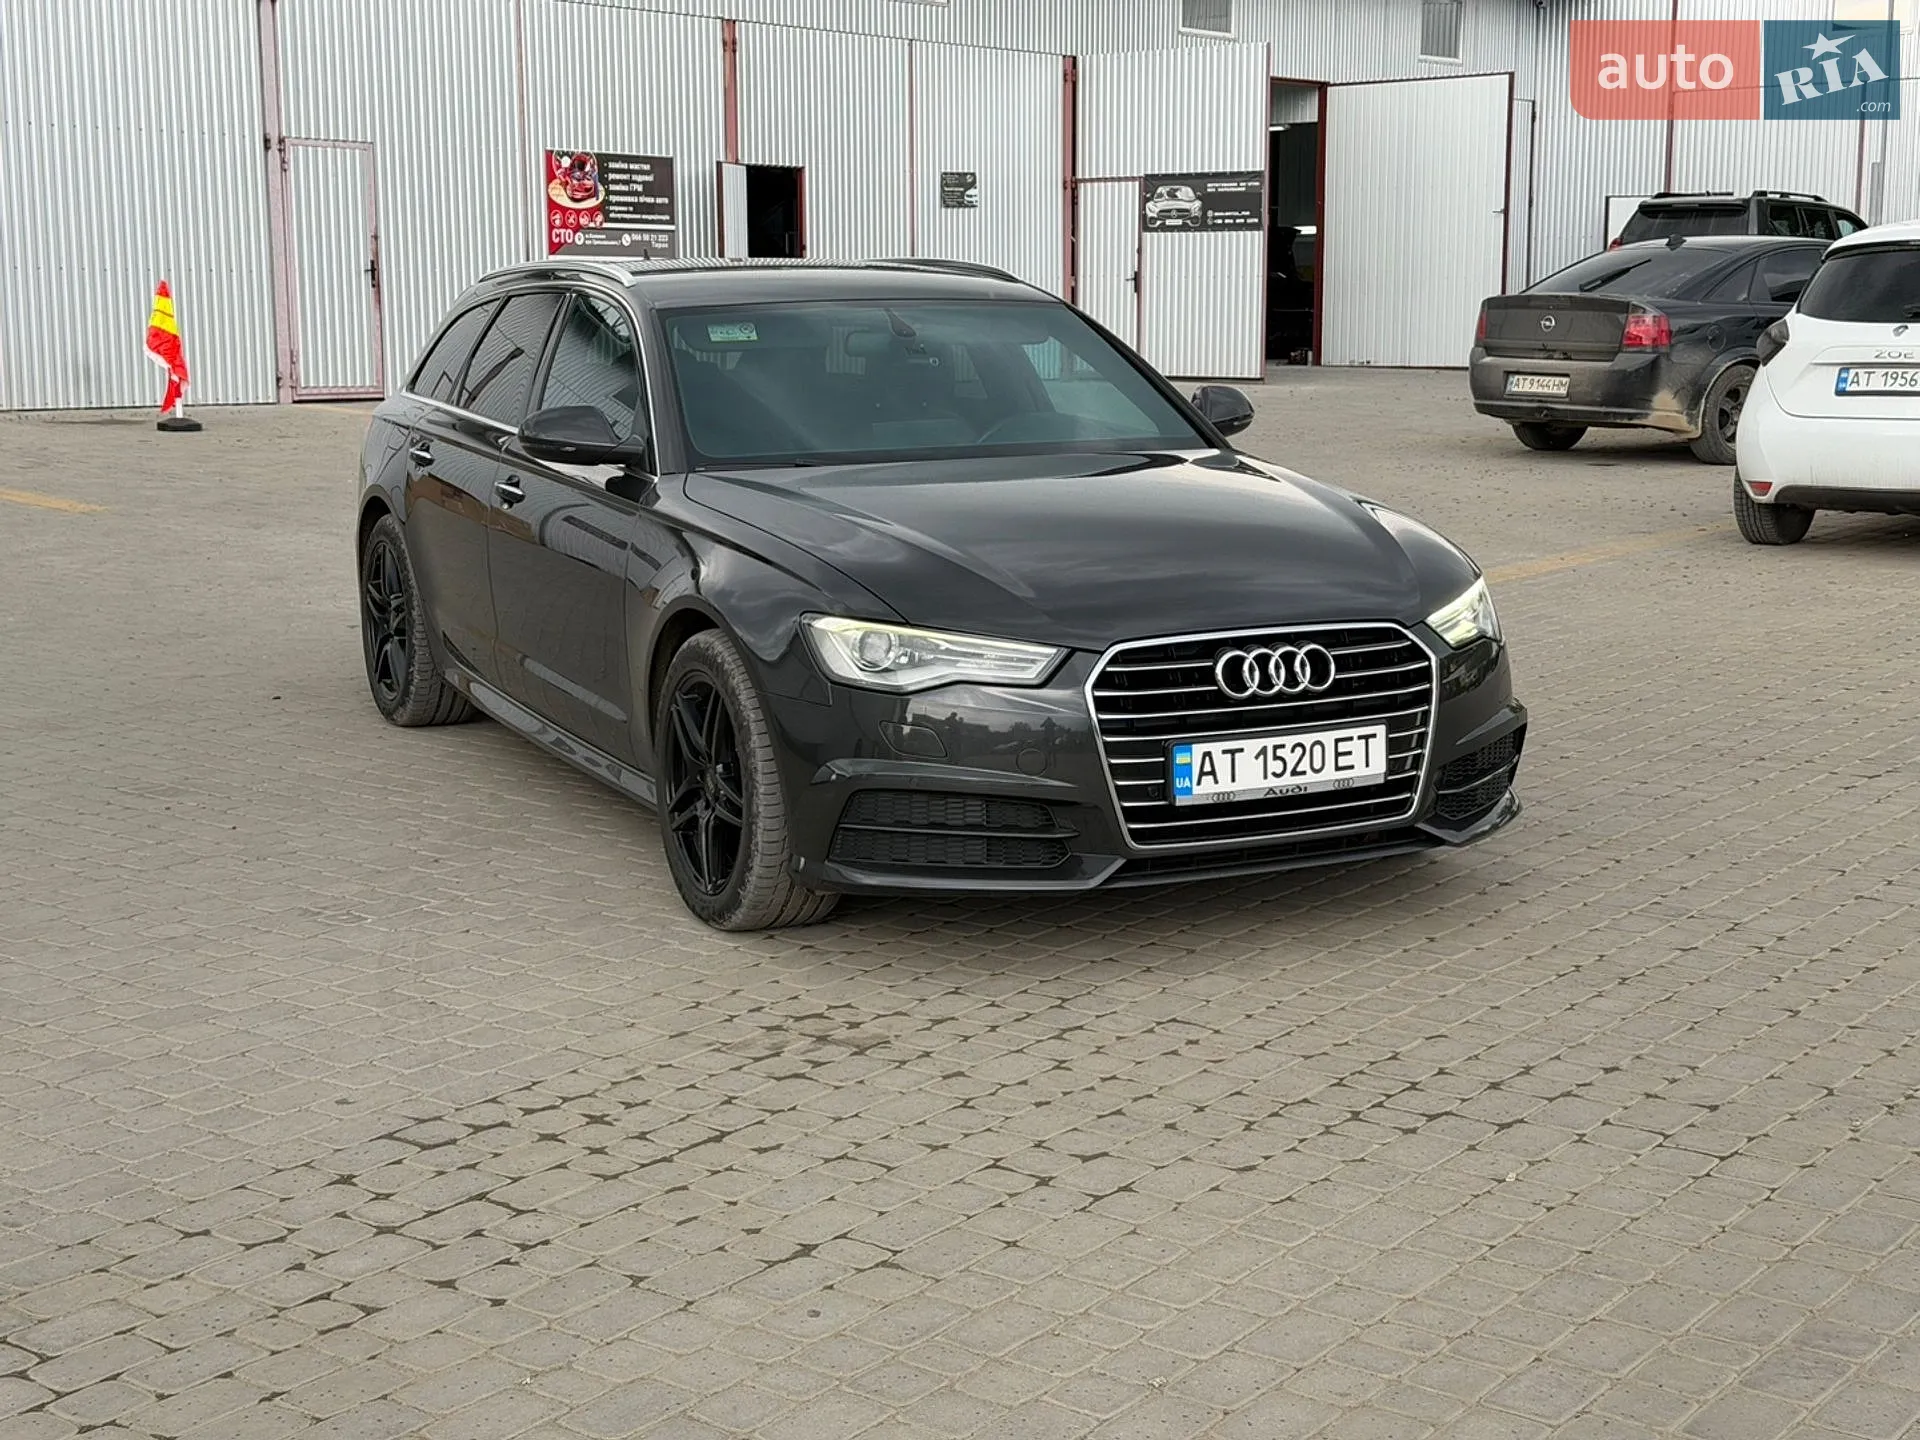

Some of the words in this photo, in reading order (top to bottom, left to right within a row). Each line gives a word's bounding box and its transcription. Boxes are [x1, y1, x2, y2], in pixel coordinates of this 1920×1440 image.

[552, 228, 573, 244] СТО
[1874, 350, 1914, 359] ZOE
[1849, 371, 1876, 387] AT
[1881, 371, 1920, 387] 1956
[1196, 748, 1245, 786] AT
[1254, 740, 1326, 780] 1520
[1334, 733, 1377, 772] ET
[1176, 777, 1191, 789] UA
[1263, 785, 1308, 798] Audi
